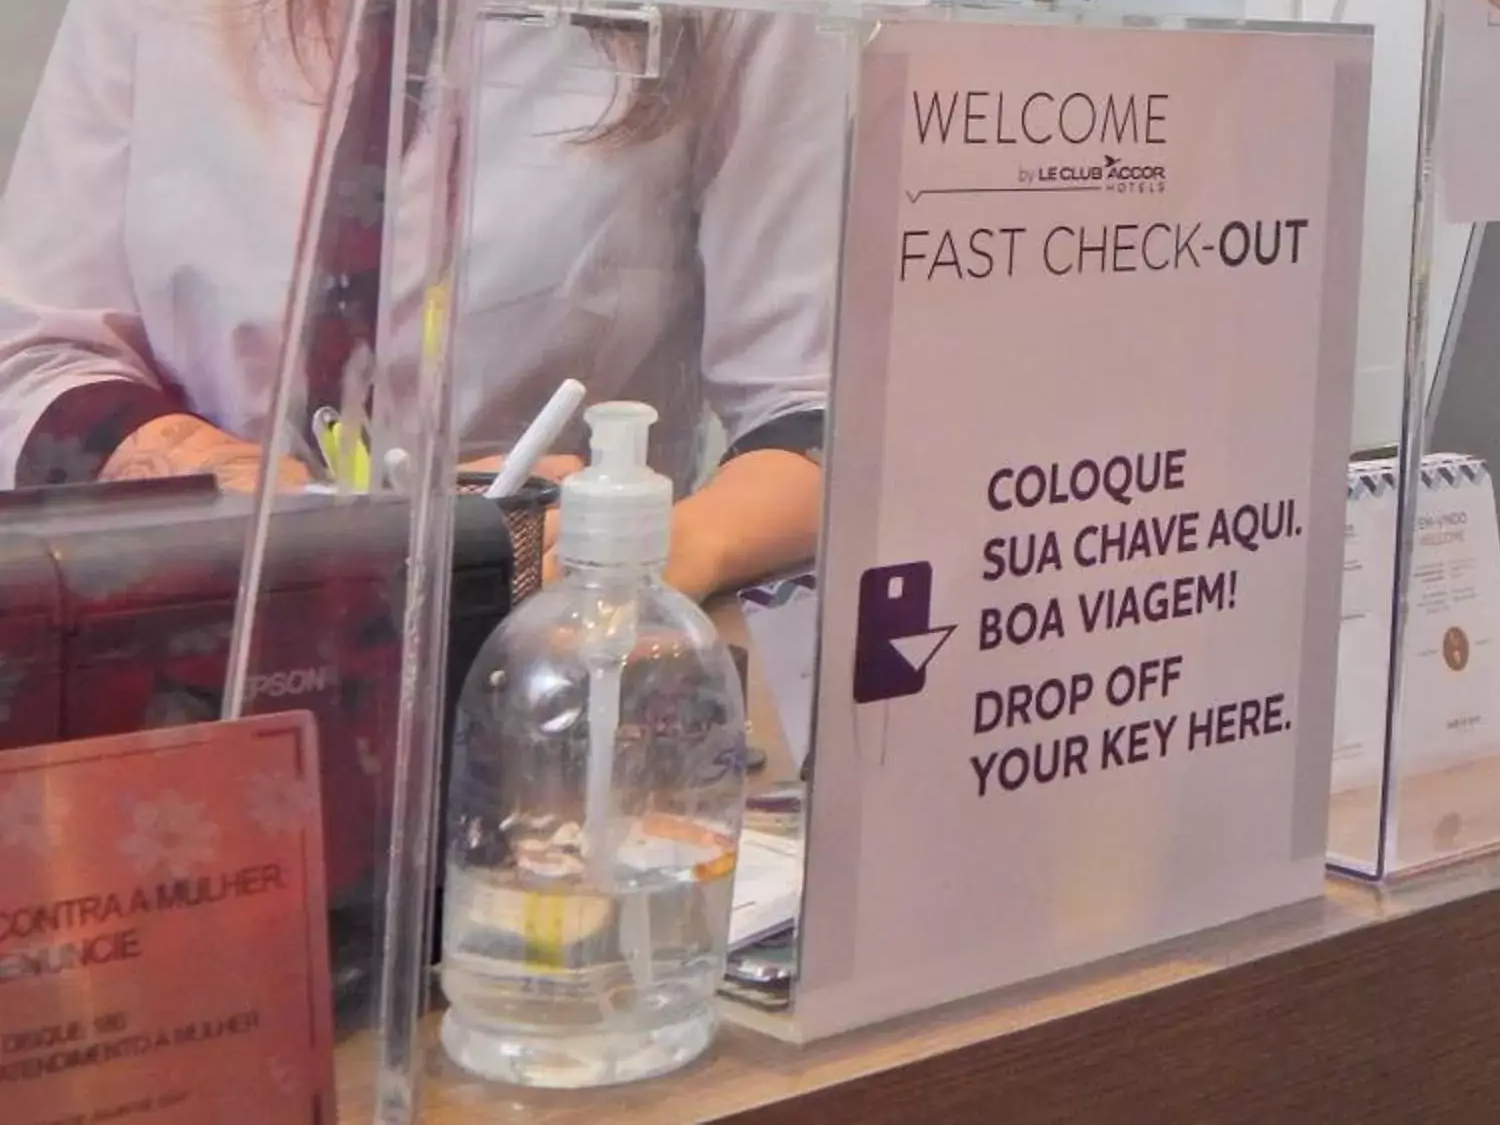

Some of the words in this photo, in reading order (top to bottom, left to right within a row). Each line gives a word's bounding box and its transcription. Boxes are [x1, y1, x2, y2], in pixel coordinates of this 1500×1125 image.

[912, 90, 1169, 144] WELCOME
[1018, 164, 1035, 183] by
[1107, 165, 1166, 180] ACCOR
[1106, 182, 1166, 194] HOTELS
[900, 227, 1027, 281] FAST
[1043, 218, 1309, 276] CHECK-OUT
[987, 448, 1187, 511] COLOQUE
[982, 530, 1062, 581] SUA
[1073, 512, 1200, 569] CHAVE
[1207, 498, 1303, 552] AQUI.
[979, 598, 1065, 651] BOA
[1079, 570, 1238, 634] VIAGEM!
[244, 667, 325, 701] PSON
[974, 672, 1093, 734] DROP
[1106, 655, 1184, 707] OFF
[969, 734, 1089, 797] YOUR
[1101, 715, 1177, 770] KEY
[1188, 693, 1292, 751] HERE.
[156, 862, 287, 910] MULHER
